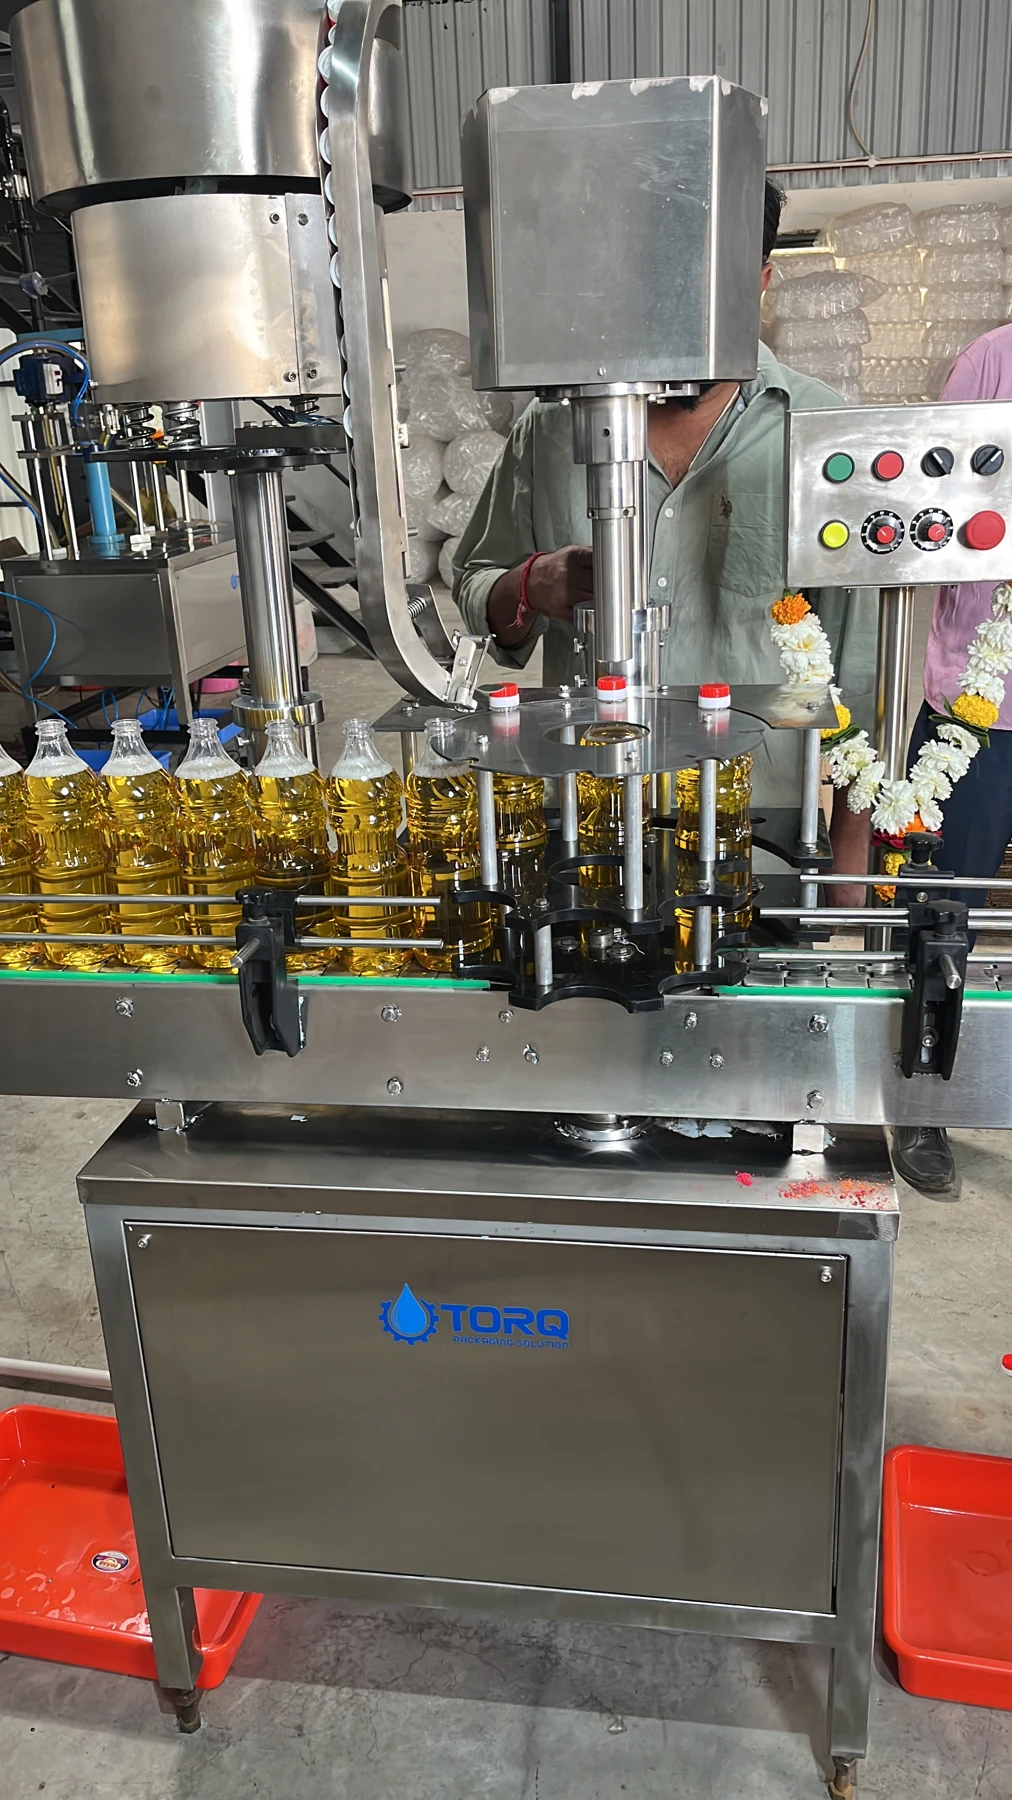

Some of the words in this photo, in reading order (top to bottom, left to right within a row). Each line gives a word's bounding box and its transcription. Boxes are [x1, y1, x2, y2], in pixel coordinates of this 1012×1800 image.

[440, 1303, 569, 1339] TORQ
[453, 1335, 514, 1346] PACKAGING
[516, 1338, 569, 1349] SOLUTION
